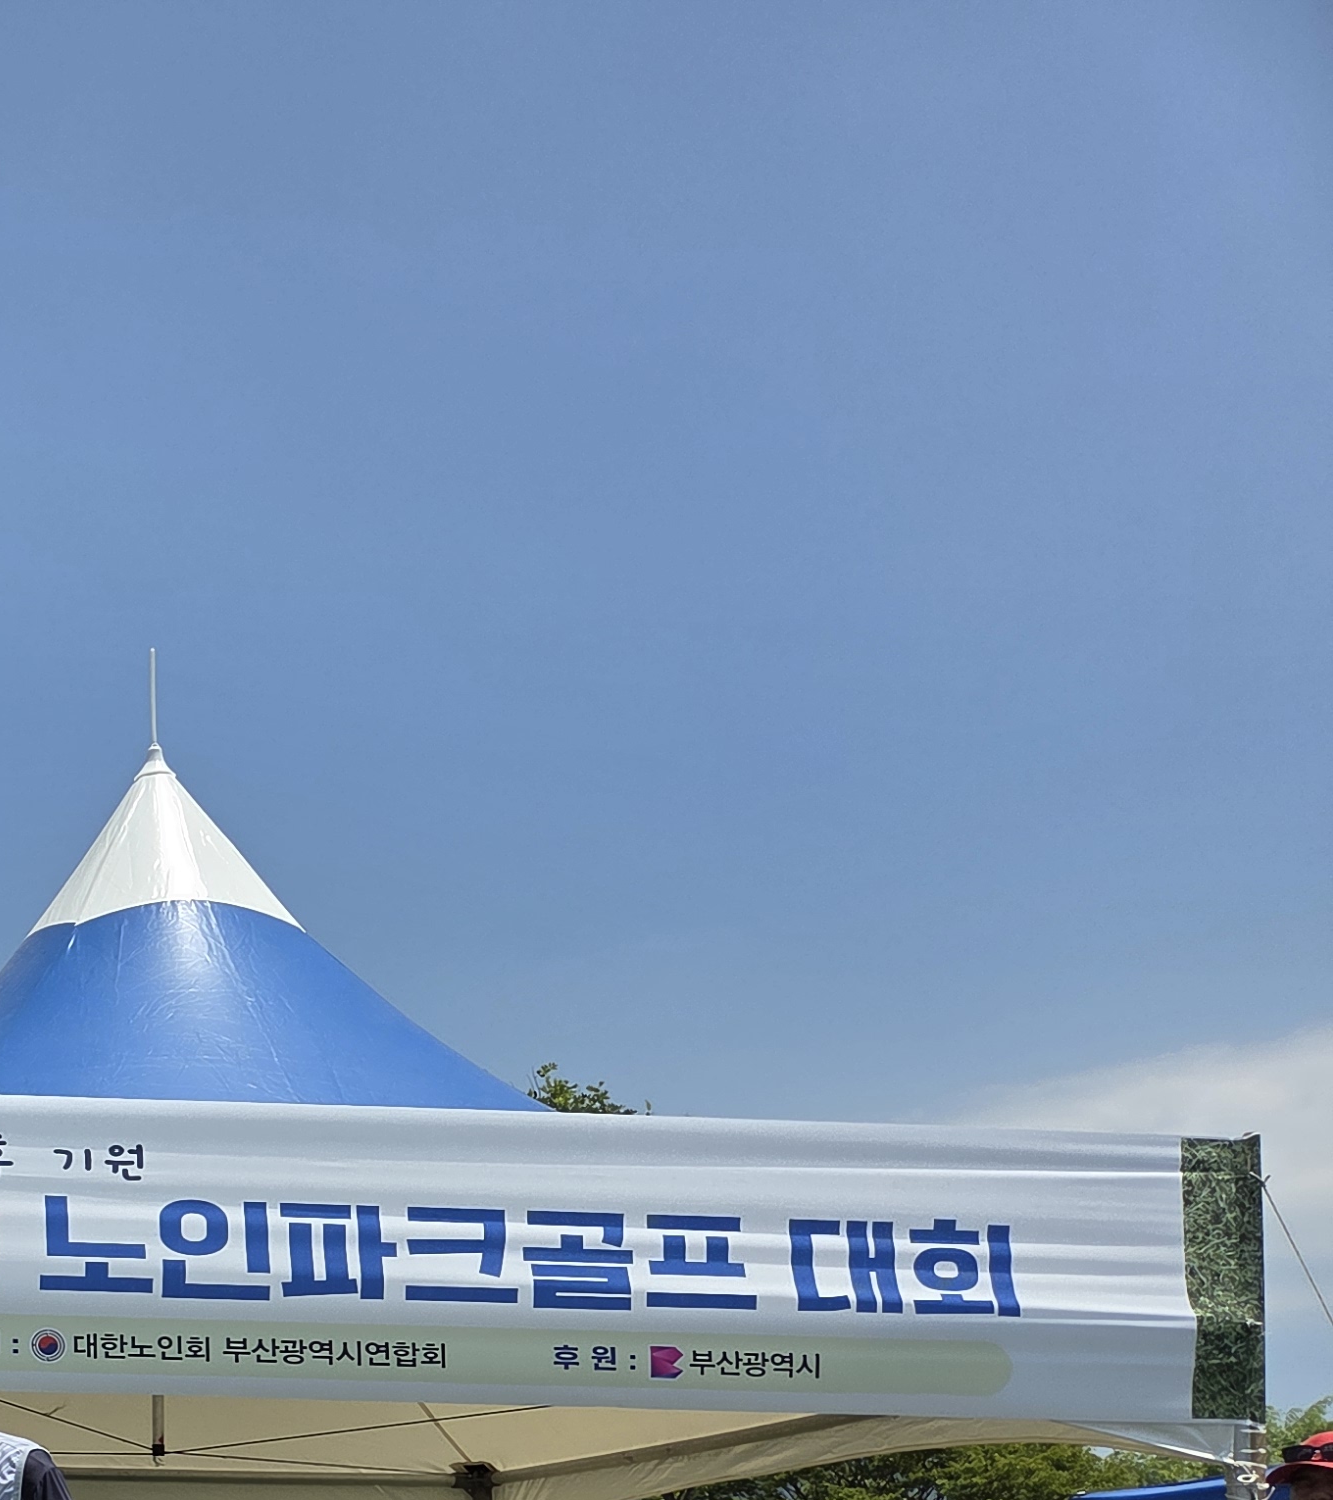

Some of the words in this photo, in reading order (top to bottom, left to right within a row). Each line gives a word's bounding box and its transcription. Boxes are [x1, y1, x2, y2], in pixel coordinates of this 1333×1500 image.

[53, 1144, 144, 1181] 기원
[39, 1194, 758, 1311] 노인파크골프
[788, 1218, 1021, 1317] 대회
[73, 1333, 211, 1362] 대한노인회
[222, 1336, 447, 1369] 부산광역시연합회
[689, 1350, 821, 1379] 부산광역시
